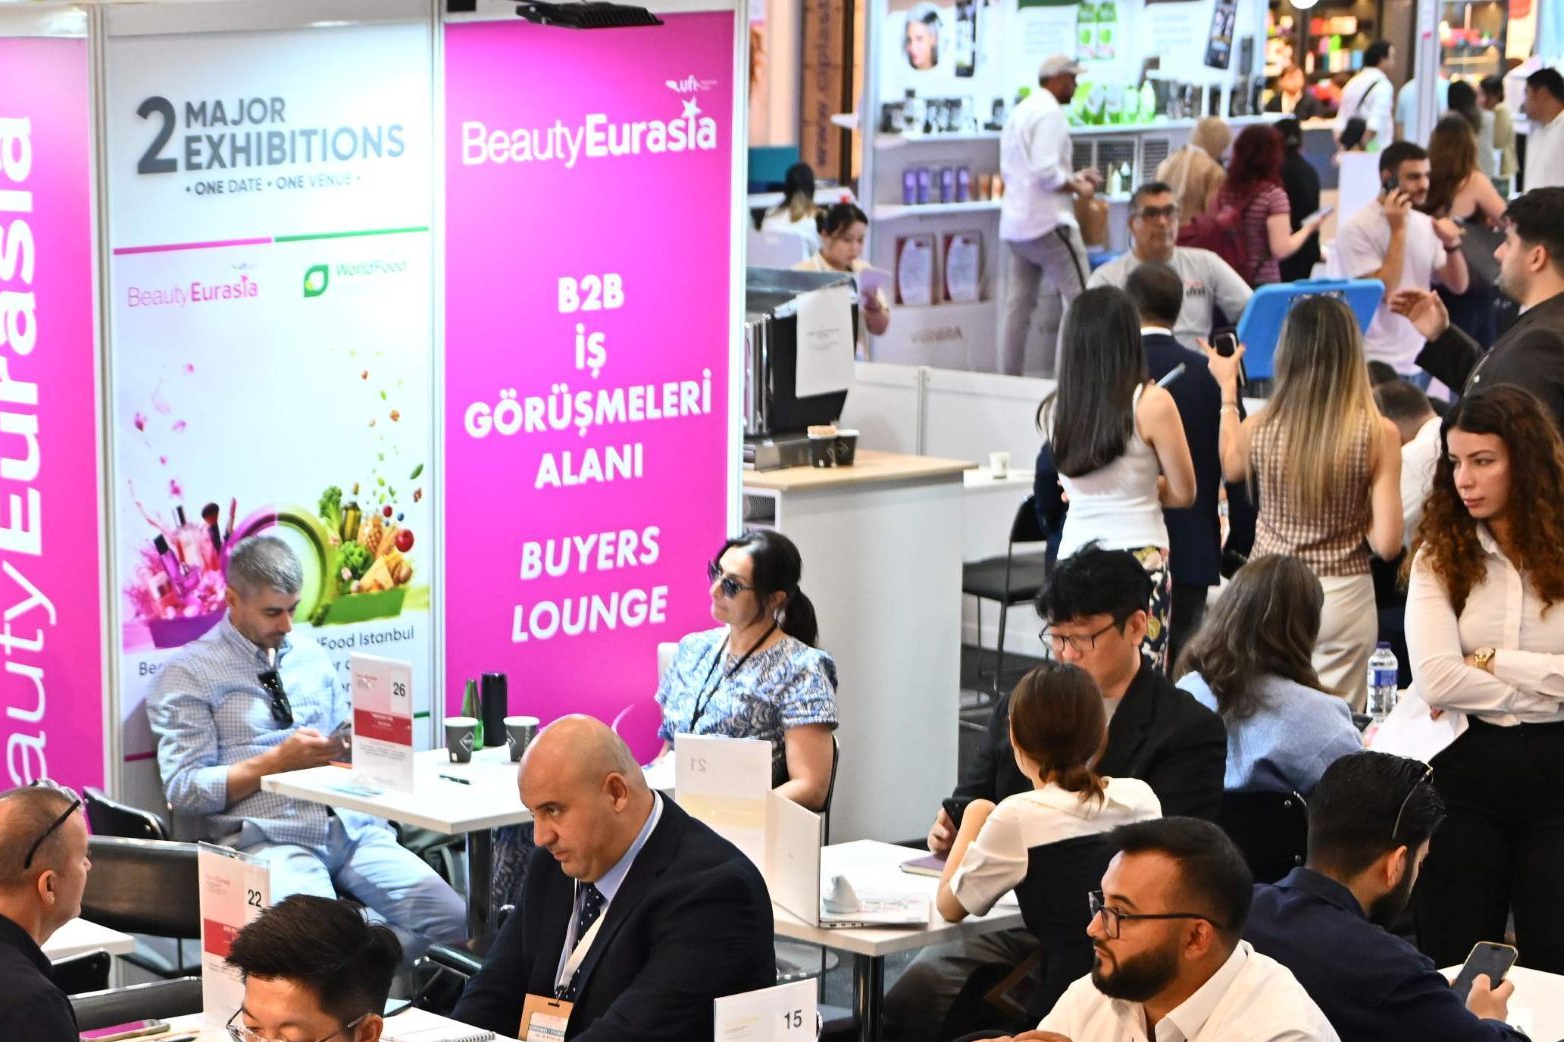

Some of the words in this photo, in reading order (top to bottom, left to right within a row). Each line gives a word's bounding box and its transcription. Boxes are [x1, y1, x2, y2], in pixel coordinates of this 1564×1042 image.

[185, 97, 286, 128] MAJOR
[462, 97, 717, 169] BeautyEurasia
[136, 96, 177, 175] 2
[185, 124, 406, 171] EXHIBITIONS
[195, 181, 224, 196] ONE
[228, 178, 262, 193] DATE
[276, 176, 304, 190] ONE
[309, 173, 352, 188] VENUE
[128, 276, 259, 308] BeautyEurasia
[557, 273, 625, 314] B2B
[575, 323, 606, 379] İŞ
[463, 368, 712, 440] GÖRÜŞMELERİ
[535, 444, 644, 490] ALANI
[520, 525, 661, 581] BUYERS
[360, 625, 414, 646] Istanbul
[511, 585, 669, 643] LOUNGE
[393, 682, 406, 698] 26
[247, 889, 262, 908] 22
[784, 1010, 803, 1029] 15
